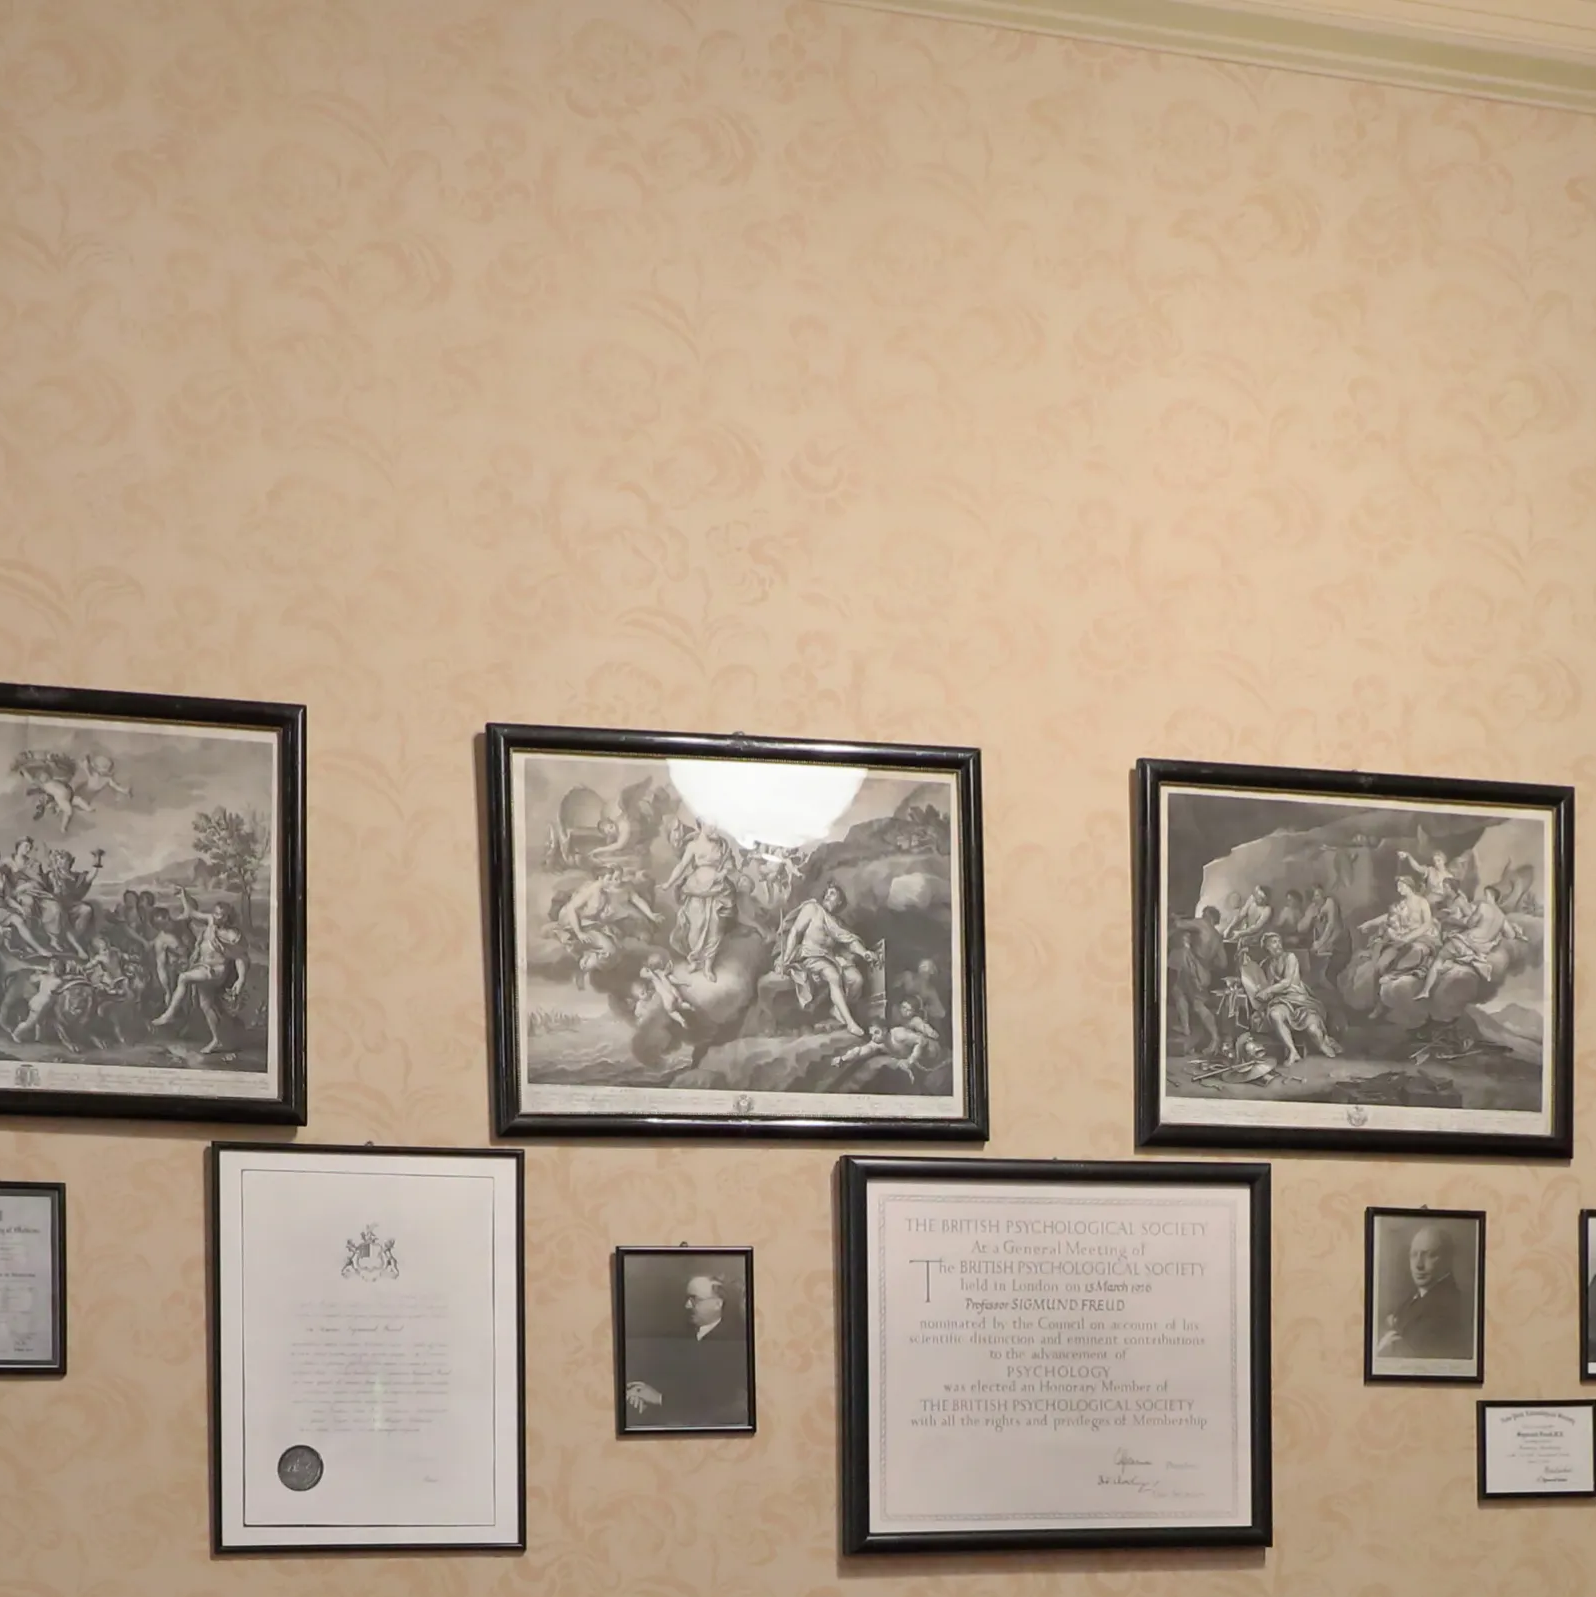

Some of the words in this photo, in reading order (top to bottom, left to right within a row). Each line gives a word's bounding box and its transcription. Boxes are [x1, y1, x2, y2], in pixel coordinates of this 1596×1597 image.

[906, 1218, 936, 1233] THE
[941, 1218, 999, 1234] BRITISH
[1006, 1219, 1134, 1236] PSYCHOLOGICAL
[1141, 1222, 1206, 1236] SOCIETY
[1003, 1241, 1061, 1256] General
[1066, 1242, 1128, 1261] Meeting
[960, 1260, 1013, 1275] BRITISH
[1017, 1261, 1139, 1277] PSYCHOLOGICAL
[1144, 1263, 1205, 1277] SOCIETY
[961, 1278, 987, 1292] held
[993, 1279, 1006, 1292] in
[1012, 1279, 1059, 1292] London
[1065, 1282, 1080, 1292] on
[1096, 1280, 1128, 1292] March
[1011, 1298, 1078, 1311] SIGMUND
[1081, 1298, 1125, 1311] FREUD
[920, 1317, 987, 1330] nominated
[1012, 1318, 1032, 1330] the
[1038, 1317, 1085, 1331] Council
[1090, 1319, 1105, 1331] on
[970, 1333, 1035, 1346] distinction
[1041, 1333, 1061, 1346] and
[1067, 1334, 1118, 1346] eminent
[1123, 1333, 1205, 1346] contributions
[990, 1349, 1002, 1360] to
[1006, 1348, 1026, 1360] the
[1031, 1348, 1108, 1360] advancement
[1114, 1348, 1127, 1361] of
[1007, 1365, 1111, 1378] PSYCHOLOGY
[943, 1382, 965, 1394] was
[971, 1379, 1016, 1394] elected
[1040, 1379, 1097, 1394] Honorary
[1102, 1380, 1151, 1394] Member
[921, 1399, 950, 1412] THE
[952, 1399, 1008, 1412] BRITISH
[1012, 1399, 1131, 1412] PSYCHOLOGICAL
[1135, 1399, 1195, 1412] SOCIETY
[910, 1415, 937, 1428] with
[942, 1414, 955, 1427] all
[960, 1415, 980, 1427] the
[985, 1415, 1020, 1432] rights
[1026, 1415, 1047, 1427] and
[1133, 1415, 1207, 1430] Membership
